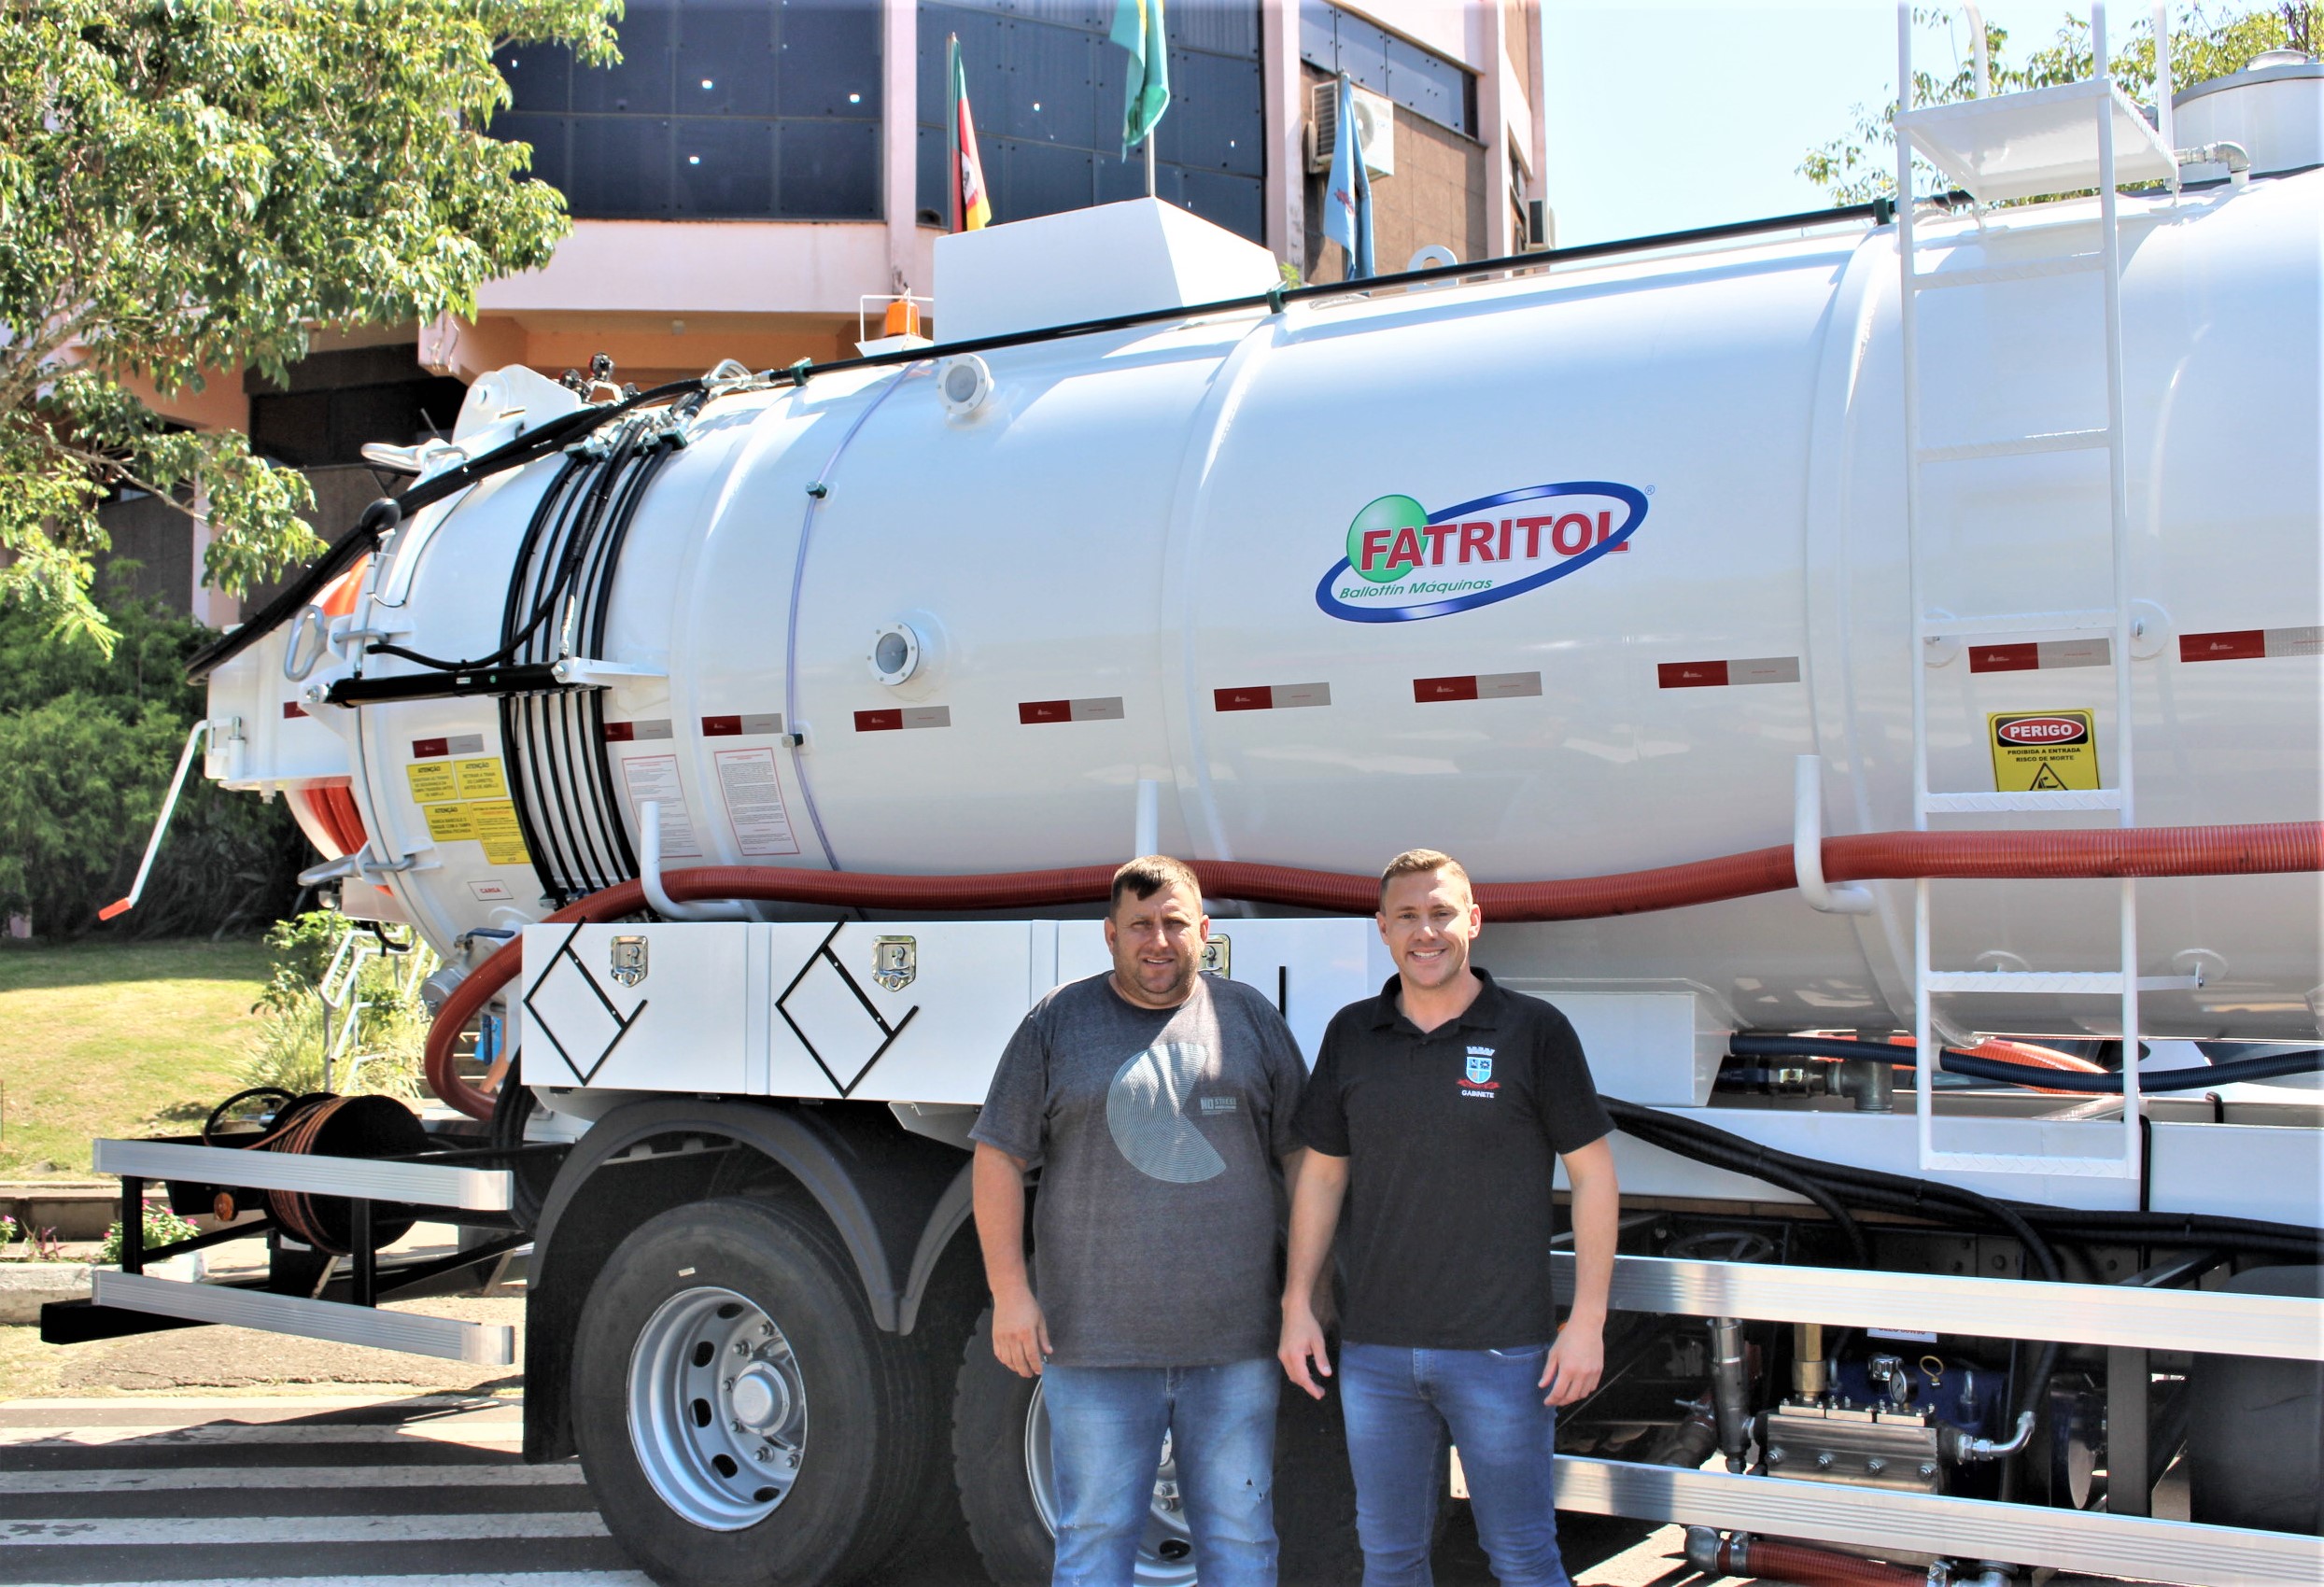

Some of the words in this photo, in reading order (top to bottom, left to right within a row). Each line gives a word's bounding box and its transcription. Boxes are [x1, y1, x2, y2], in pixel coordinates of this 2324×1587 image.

[1360, 511, 1630, 571] FATRITOL
[1338, 583, 1404, 599] Ballottin
[1408, 579, 1493, 595] Máquinas
[2009, 724, 2073, 737] PERIGO
[1461, 1089, 1495, 1099] GABINETE
